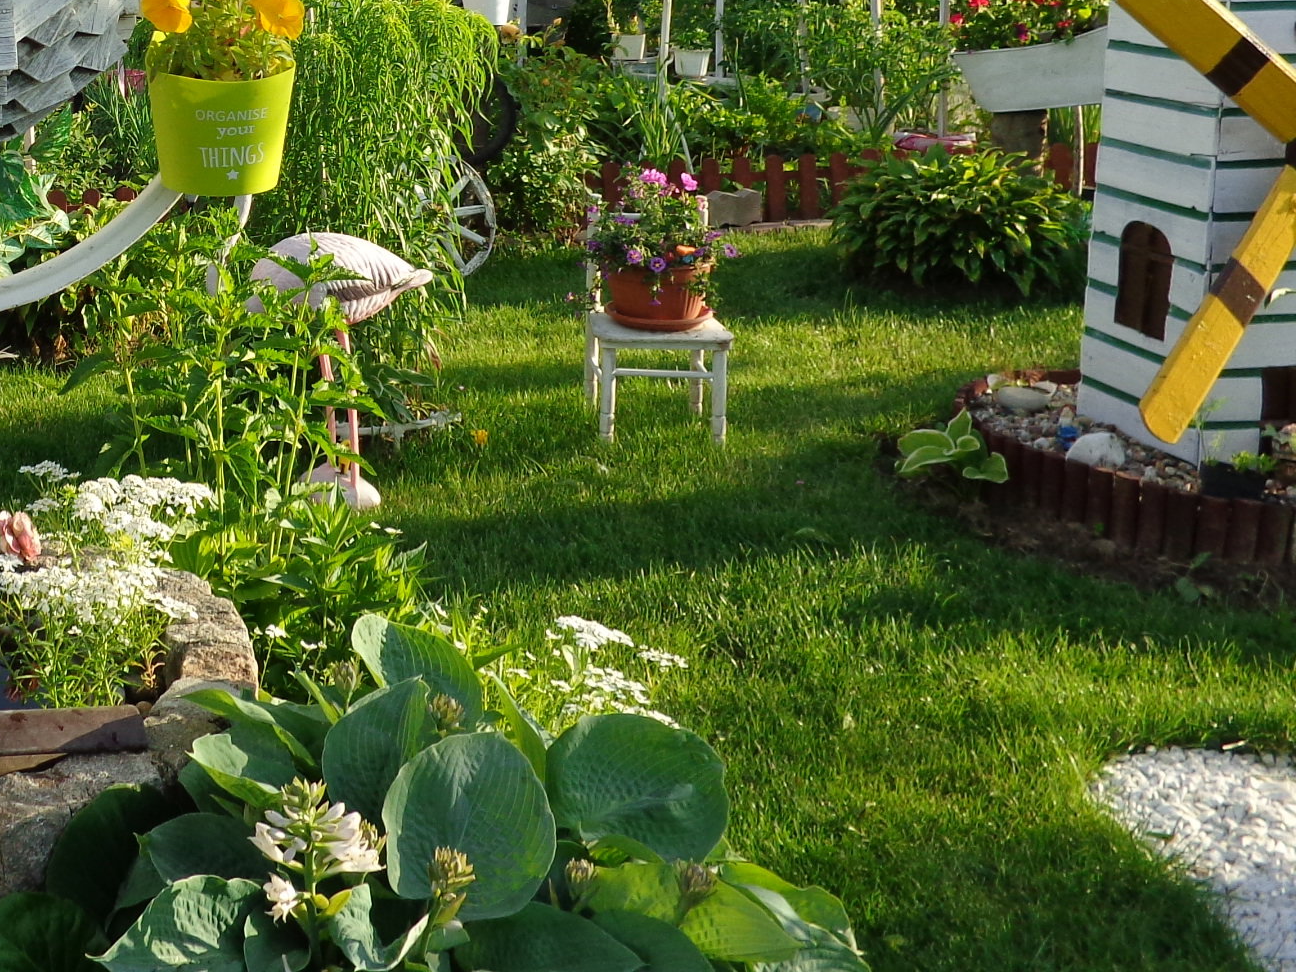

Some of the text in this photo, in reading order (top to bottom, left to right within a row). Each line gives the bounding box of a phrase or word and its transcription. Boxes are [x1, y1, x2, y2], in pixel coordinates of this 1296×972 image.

[195, 107, 269, 123] ORGANISE
[216, 125, 256, 140] your
[198, 141, 265, 168] THINGS
